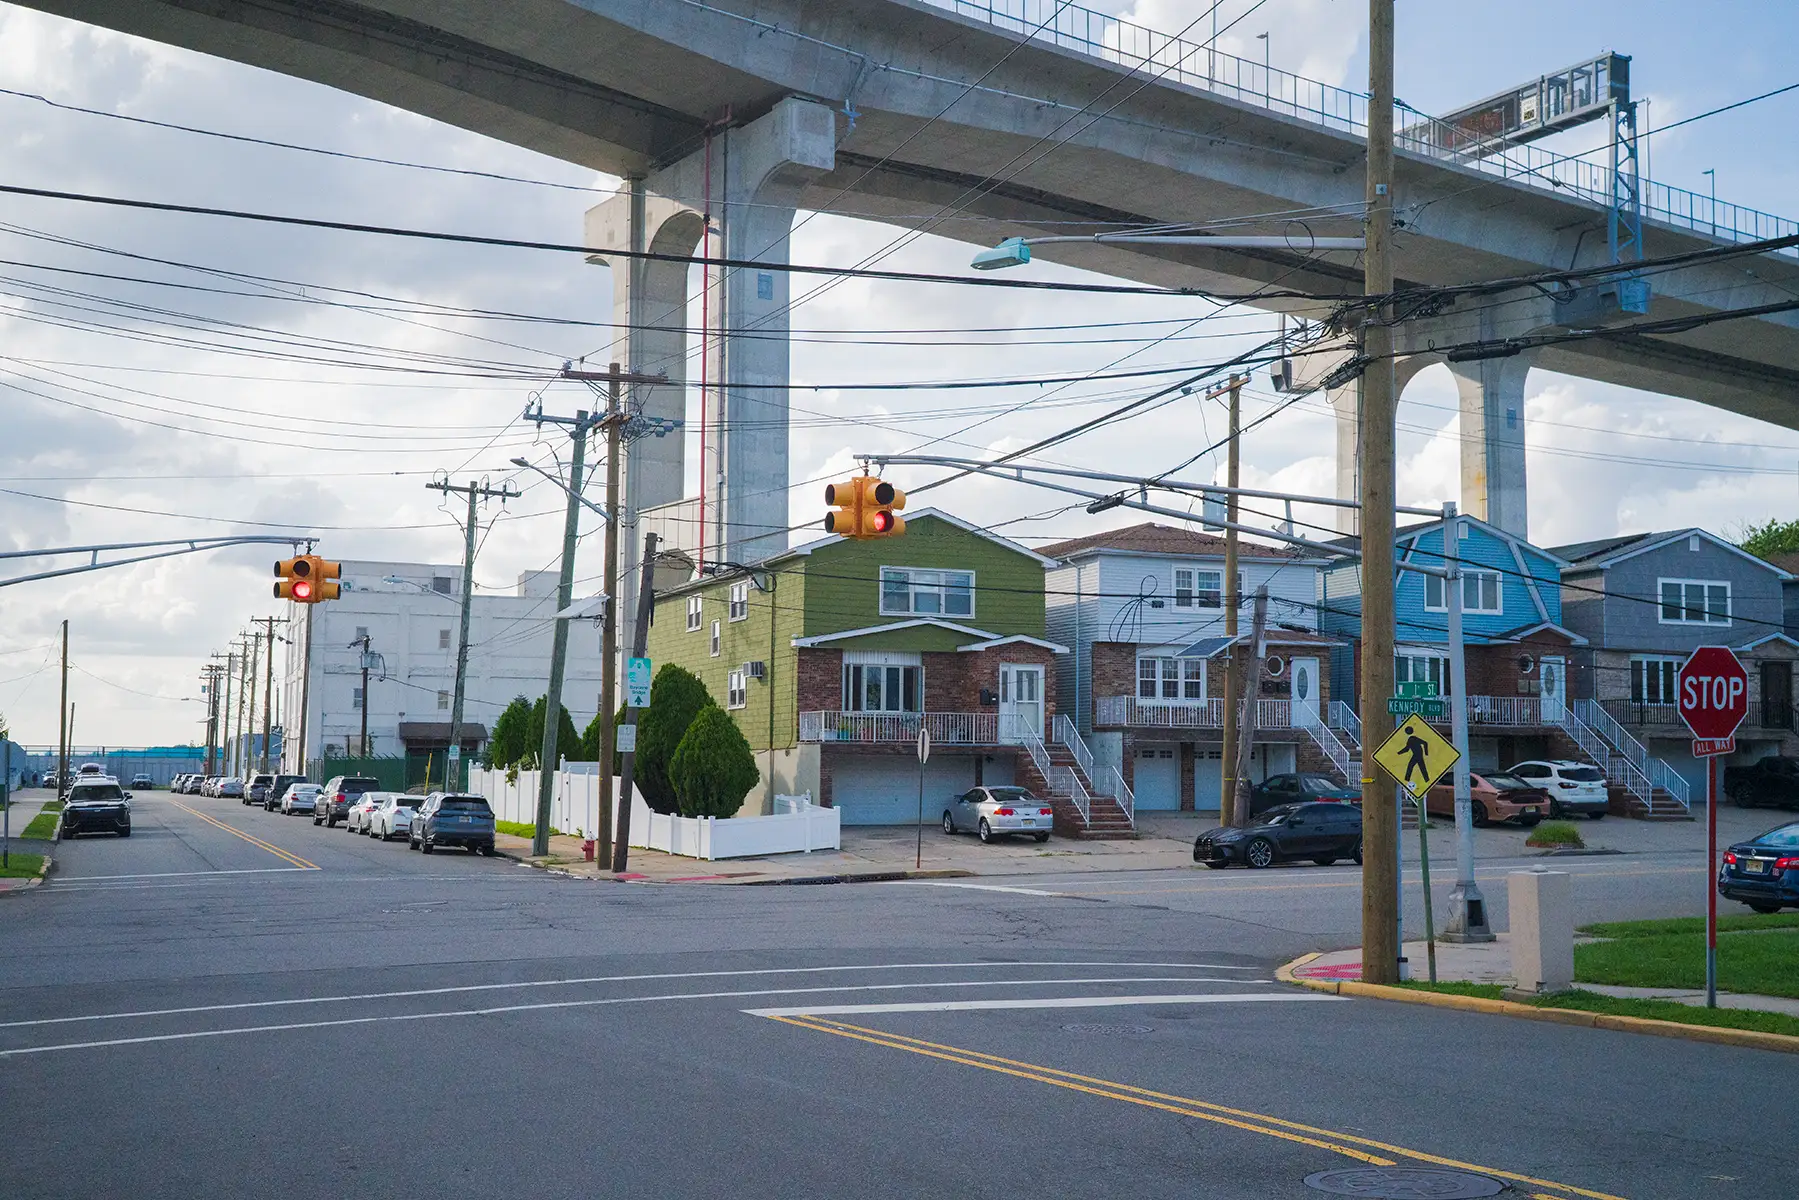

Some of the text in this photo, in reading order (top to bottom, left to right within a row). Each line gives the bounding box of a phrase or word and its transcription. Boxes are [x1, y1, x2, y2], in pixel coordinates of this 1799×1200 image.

[1427, 684, 1436, 695] ST.
[1683, 676, 1744, 710] STOP
[1389, 700, 1441, 712] KENNEDY BLVD
[1696, 740, 1731, 753] ALL WAY
